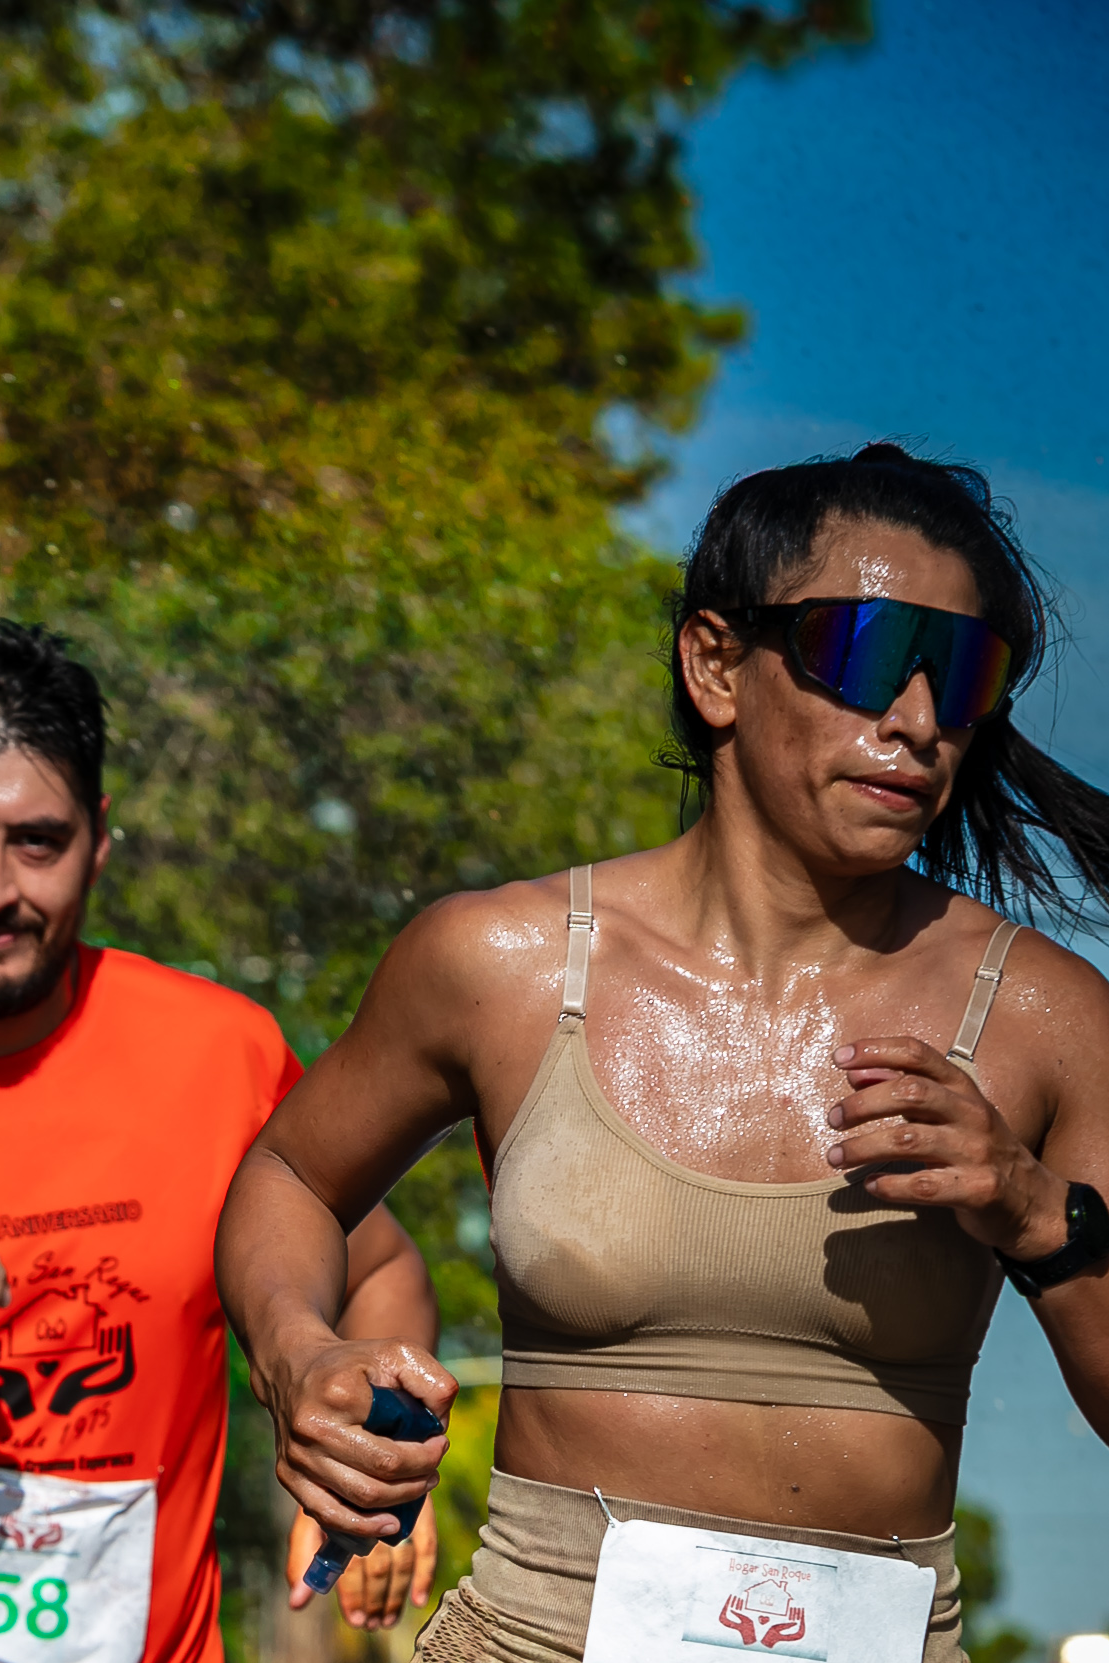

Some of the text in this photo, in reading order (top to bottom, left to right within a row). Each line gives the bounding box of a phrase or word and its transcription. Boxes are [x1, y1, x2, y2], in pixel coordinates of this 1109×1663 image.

[729, 1557, 811, 1582] Hogar San Roque
